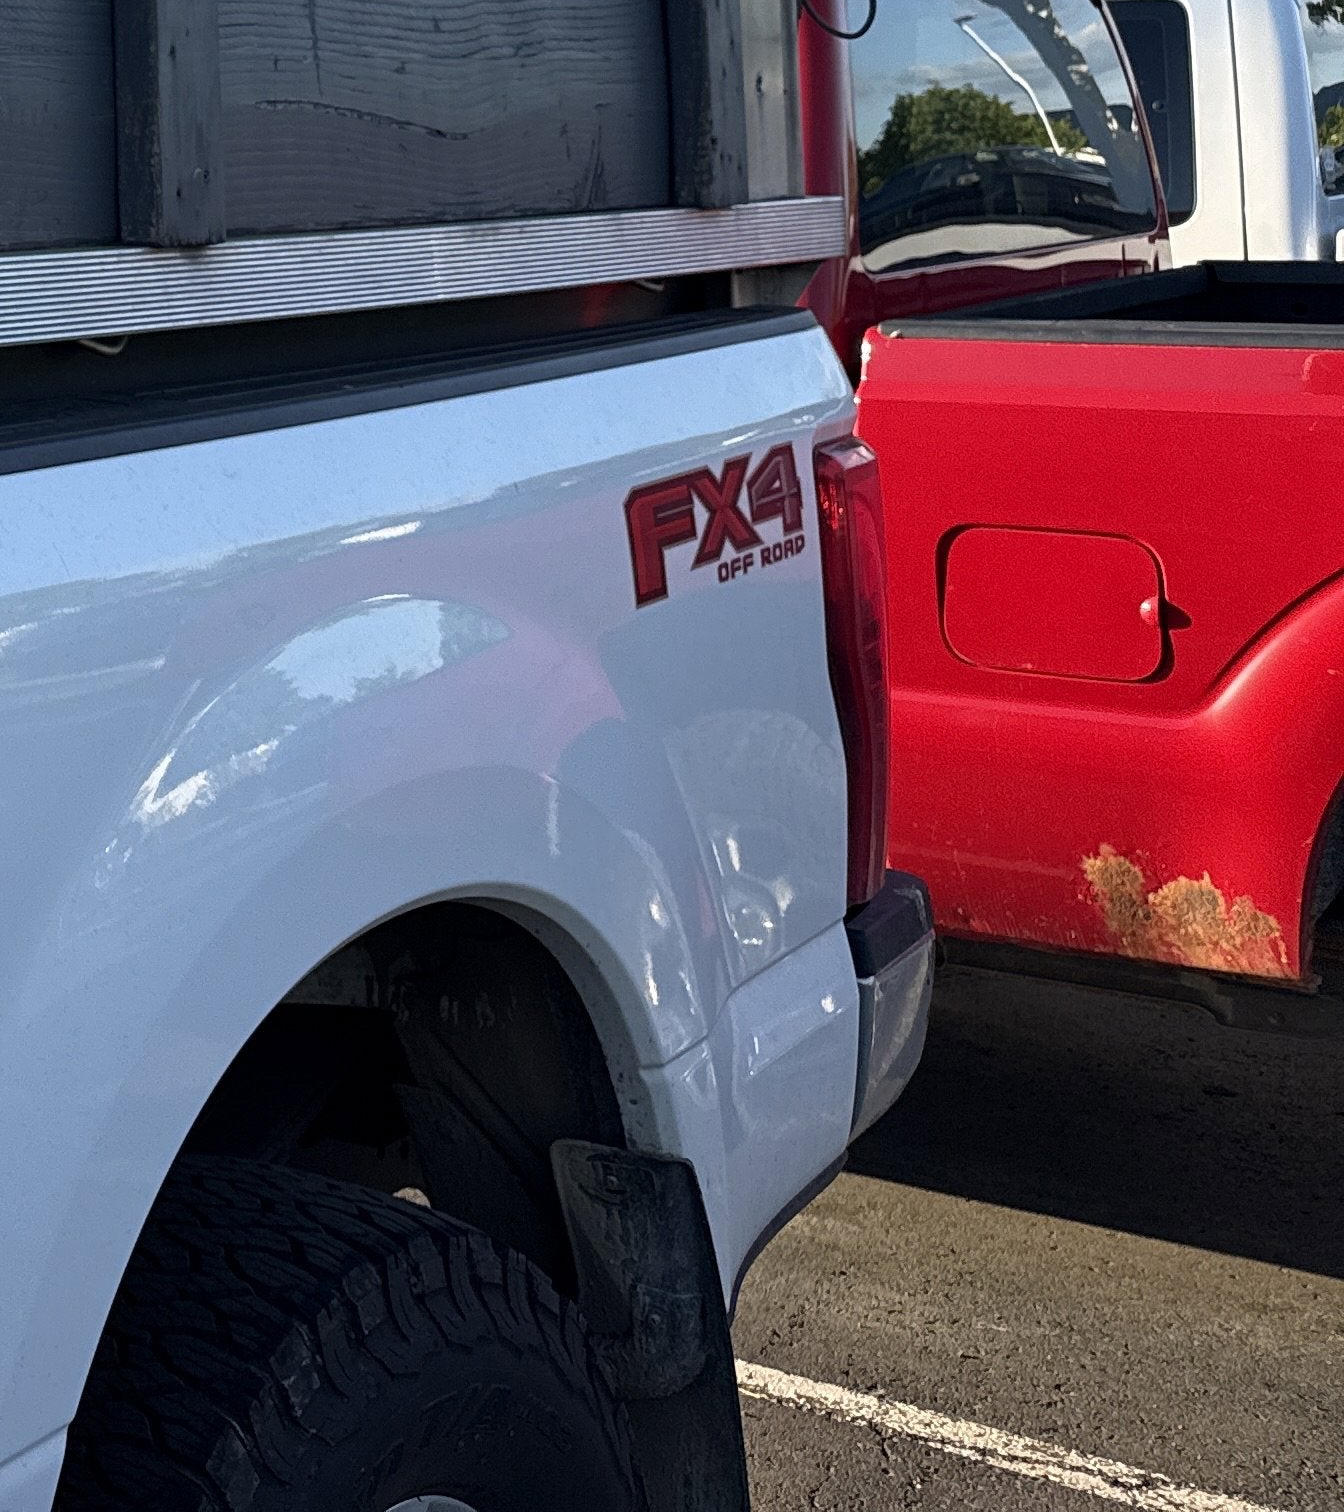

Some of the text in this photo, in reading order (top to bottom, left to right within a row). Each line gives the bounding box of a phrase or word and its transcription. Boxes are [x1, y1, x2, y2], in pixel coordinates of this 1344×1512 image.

[622, 441, 804, 609] FX4
[717, 534, 805, 583] OFF ROAD
